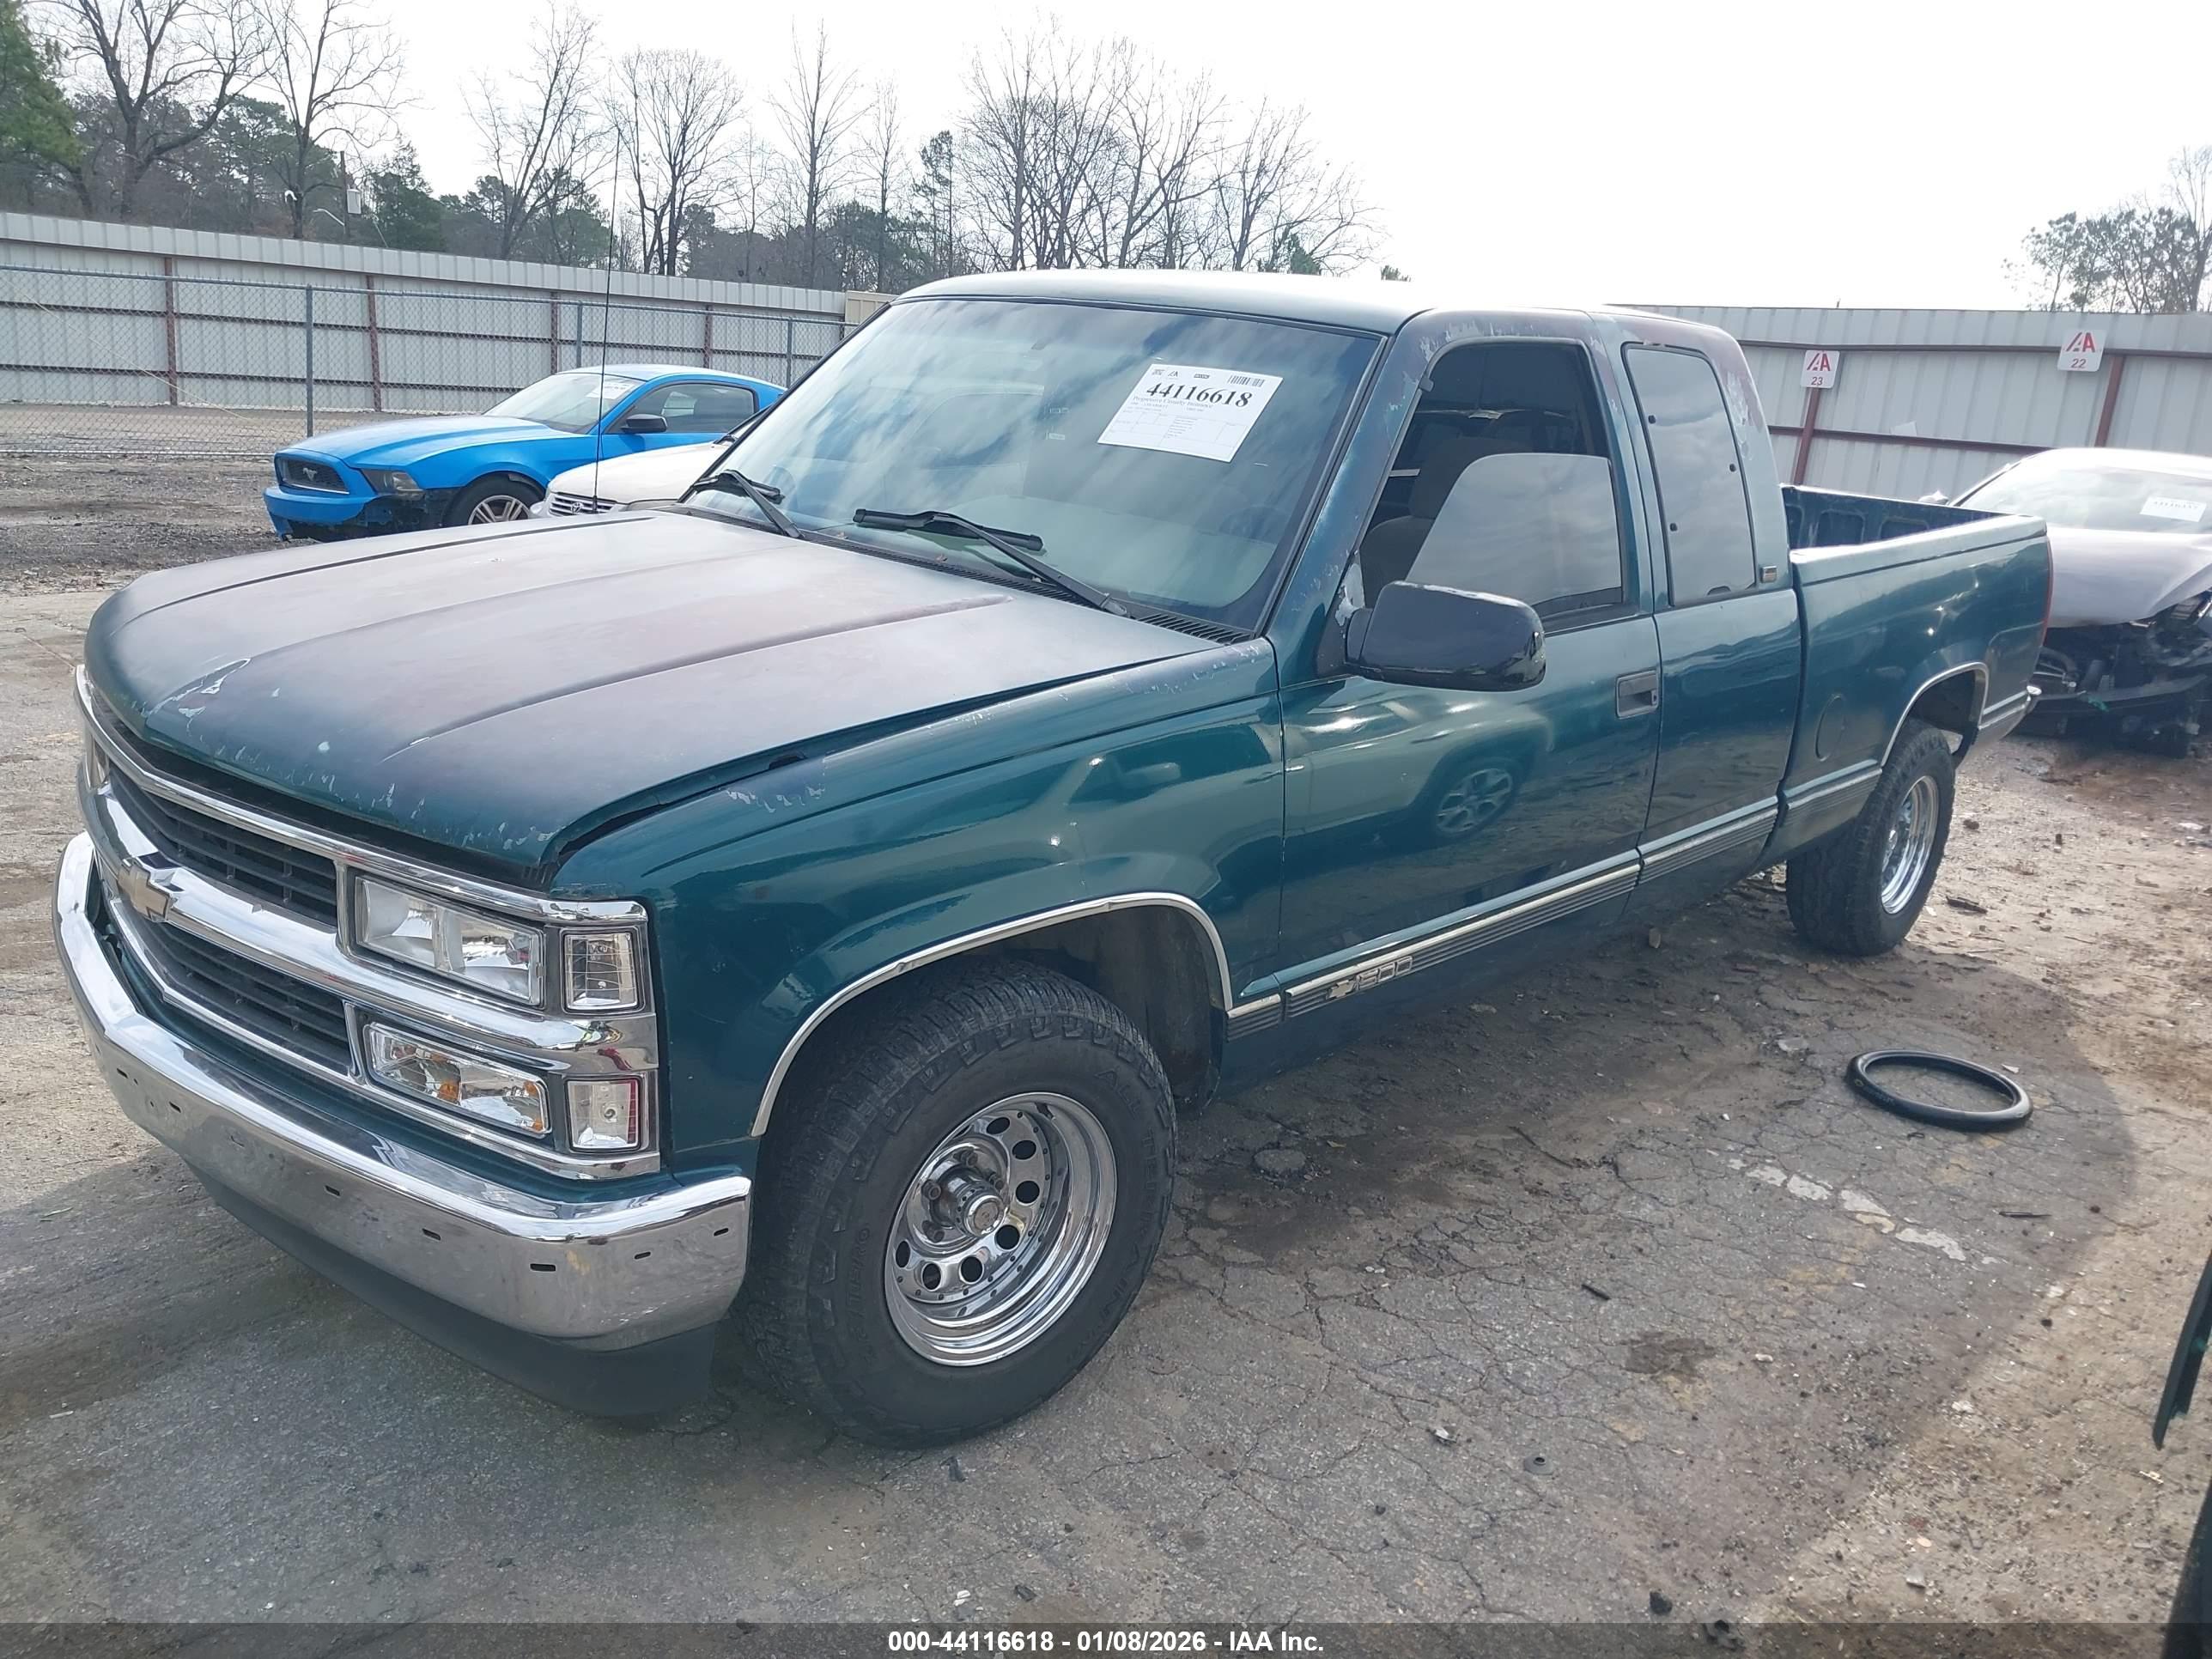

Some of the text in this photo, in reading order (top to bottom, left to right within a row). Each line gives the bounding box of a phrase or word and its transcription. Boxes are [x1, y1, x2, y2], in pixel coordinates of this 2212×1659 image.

[2070, 358, 2087, 368] 22
[1811, 376, 1823, 386] 23
[1146, 383, 1253, 408] 44116618
